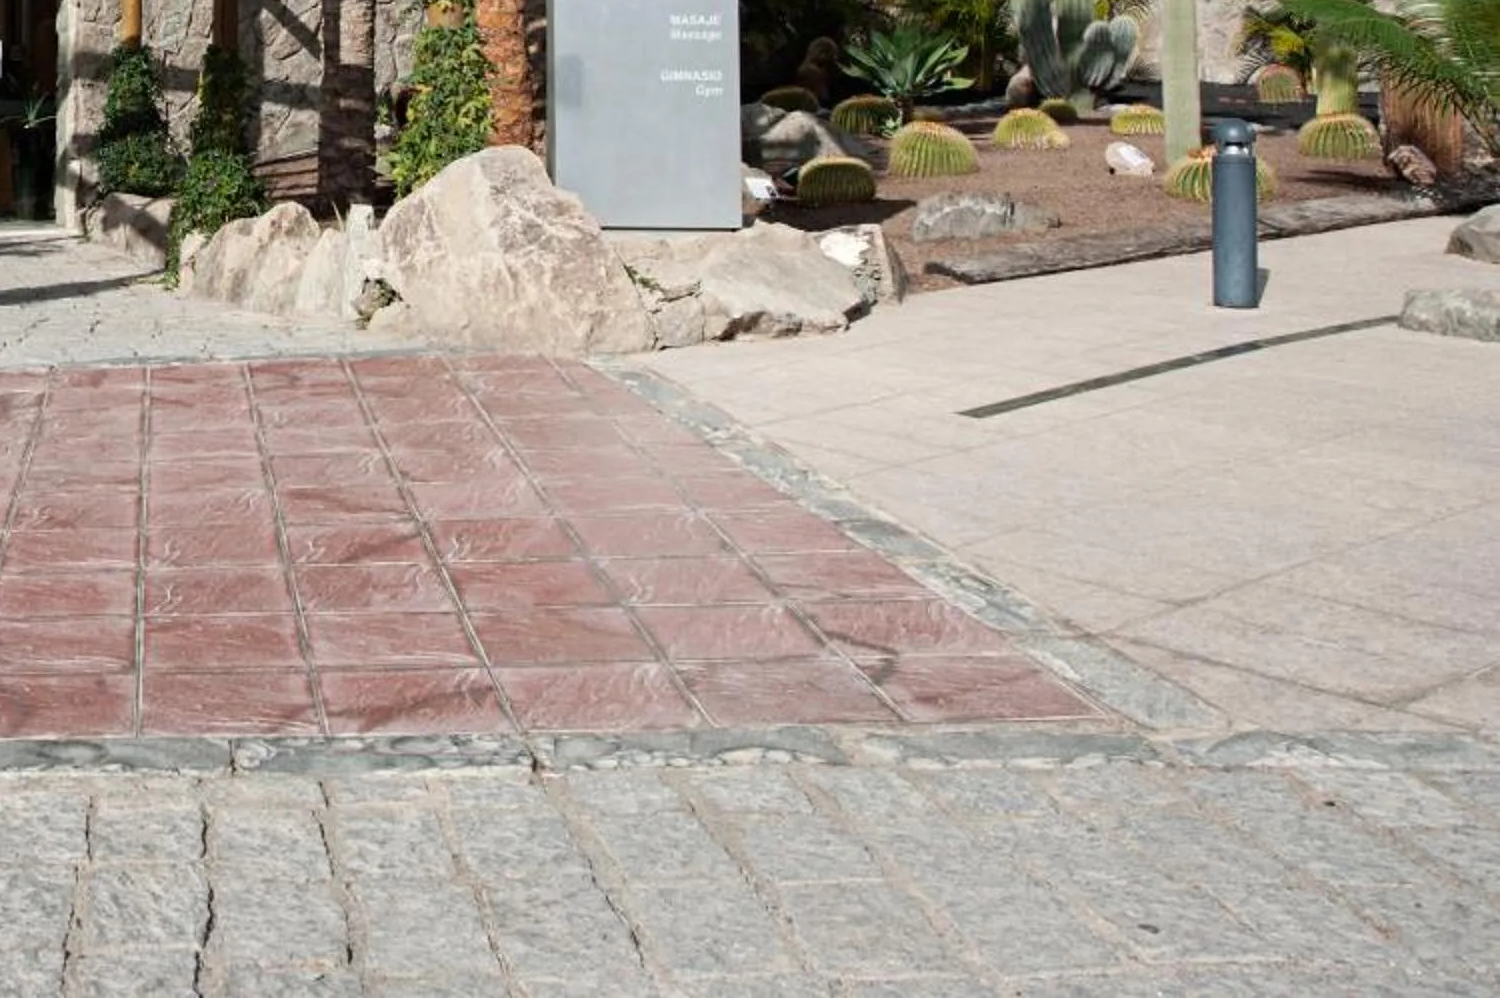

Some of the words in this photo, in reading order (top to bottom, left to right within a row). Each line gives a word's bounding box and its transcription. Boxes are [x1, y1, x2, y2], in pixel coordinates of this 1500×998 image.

[669, 14, 722, 26] MASAJE
[660, 69, 723, 81] GIMNASIO
[695, 84, 724, 98] Gym
